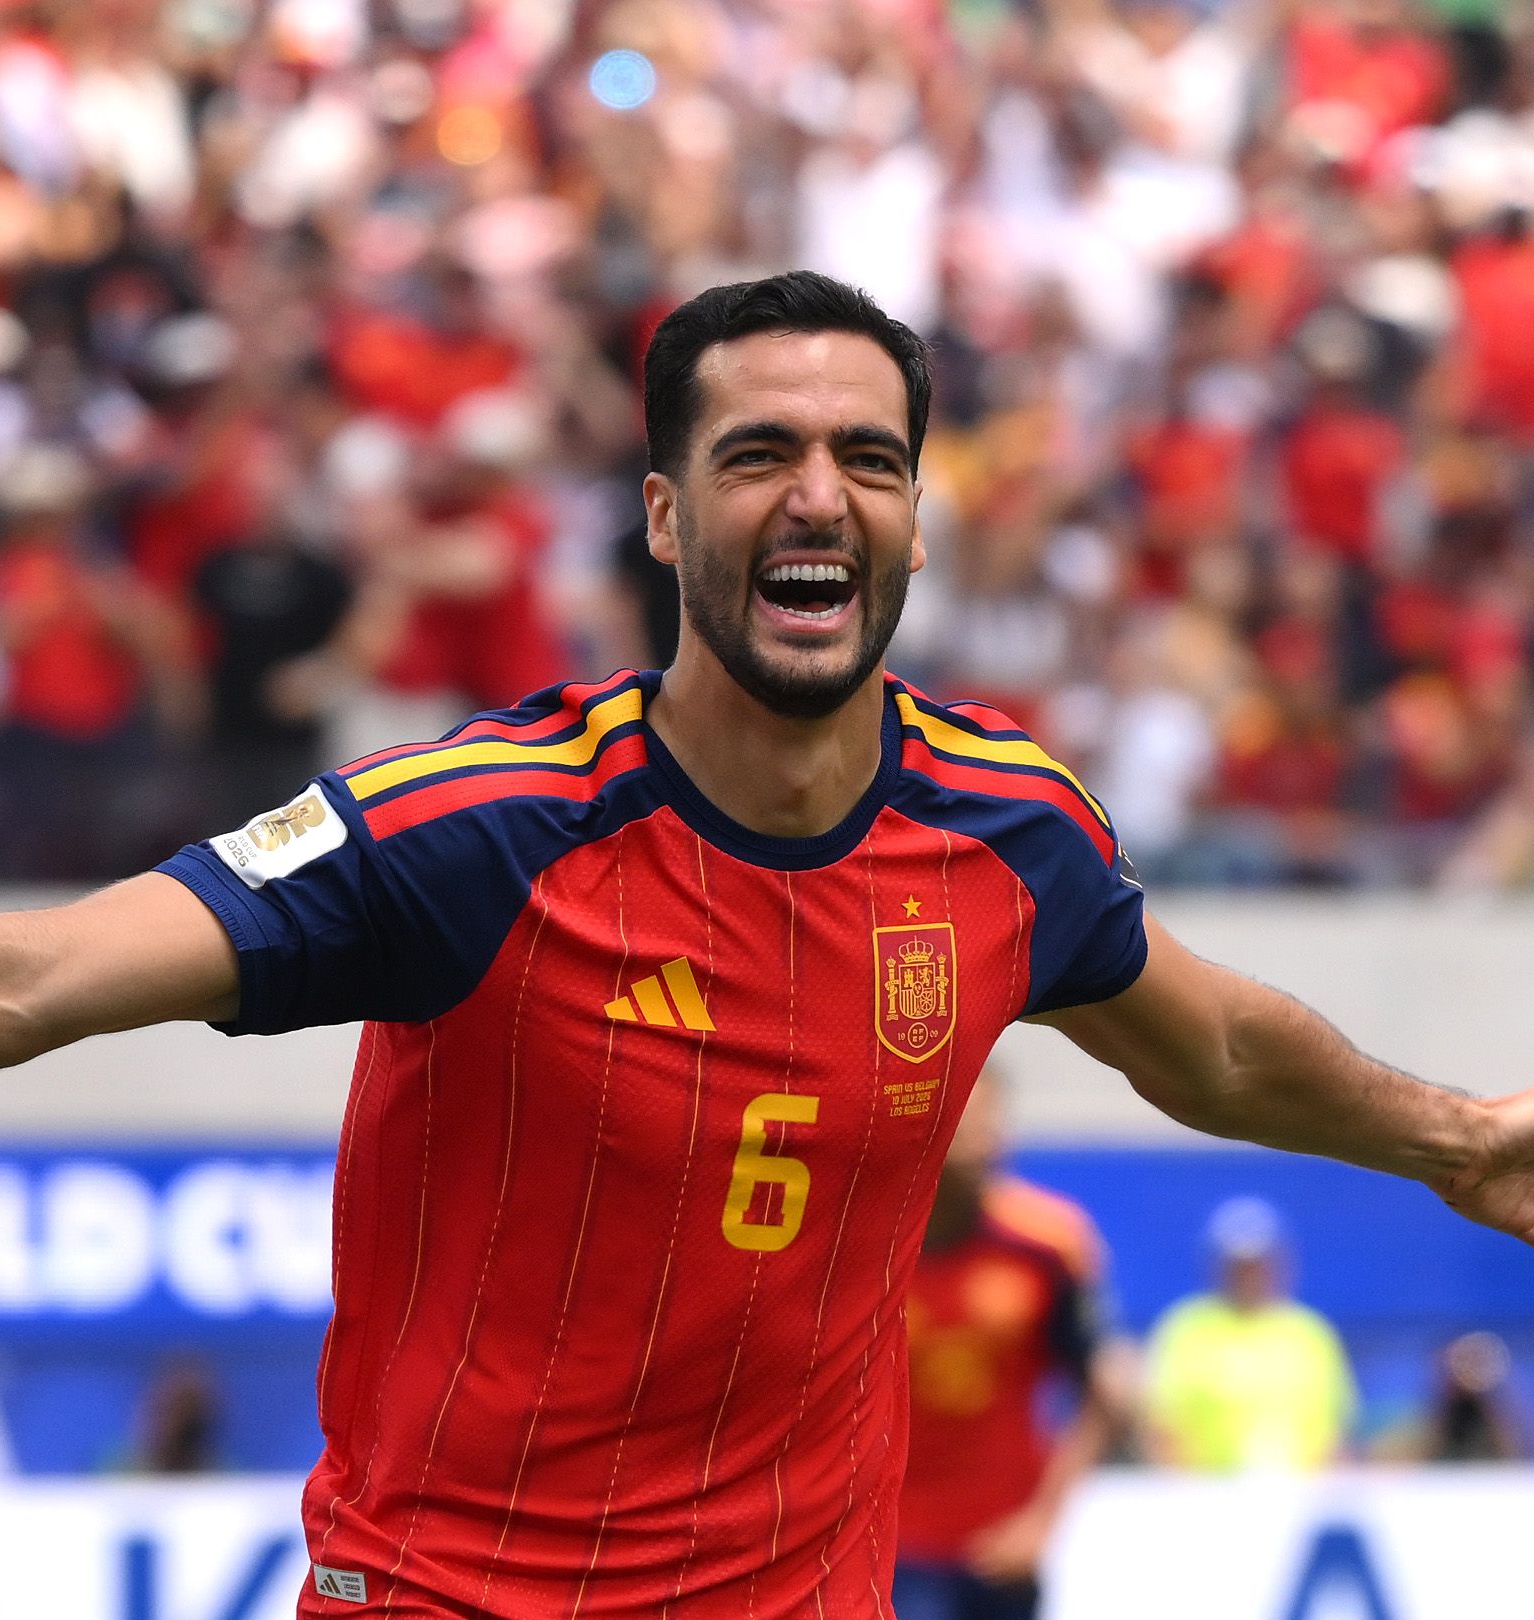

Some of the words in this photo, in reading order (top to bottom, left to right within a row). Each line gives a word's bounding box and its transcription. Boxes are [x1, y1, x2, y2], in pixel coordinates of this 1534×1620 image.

[883, 1083, 903, 1095] SPAIN
[158, 1158, 338, 1318] CU
[721, 1092, 820, 1252] 6
